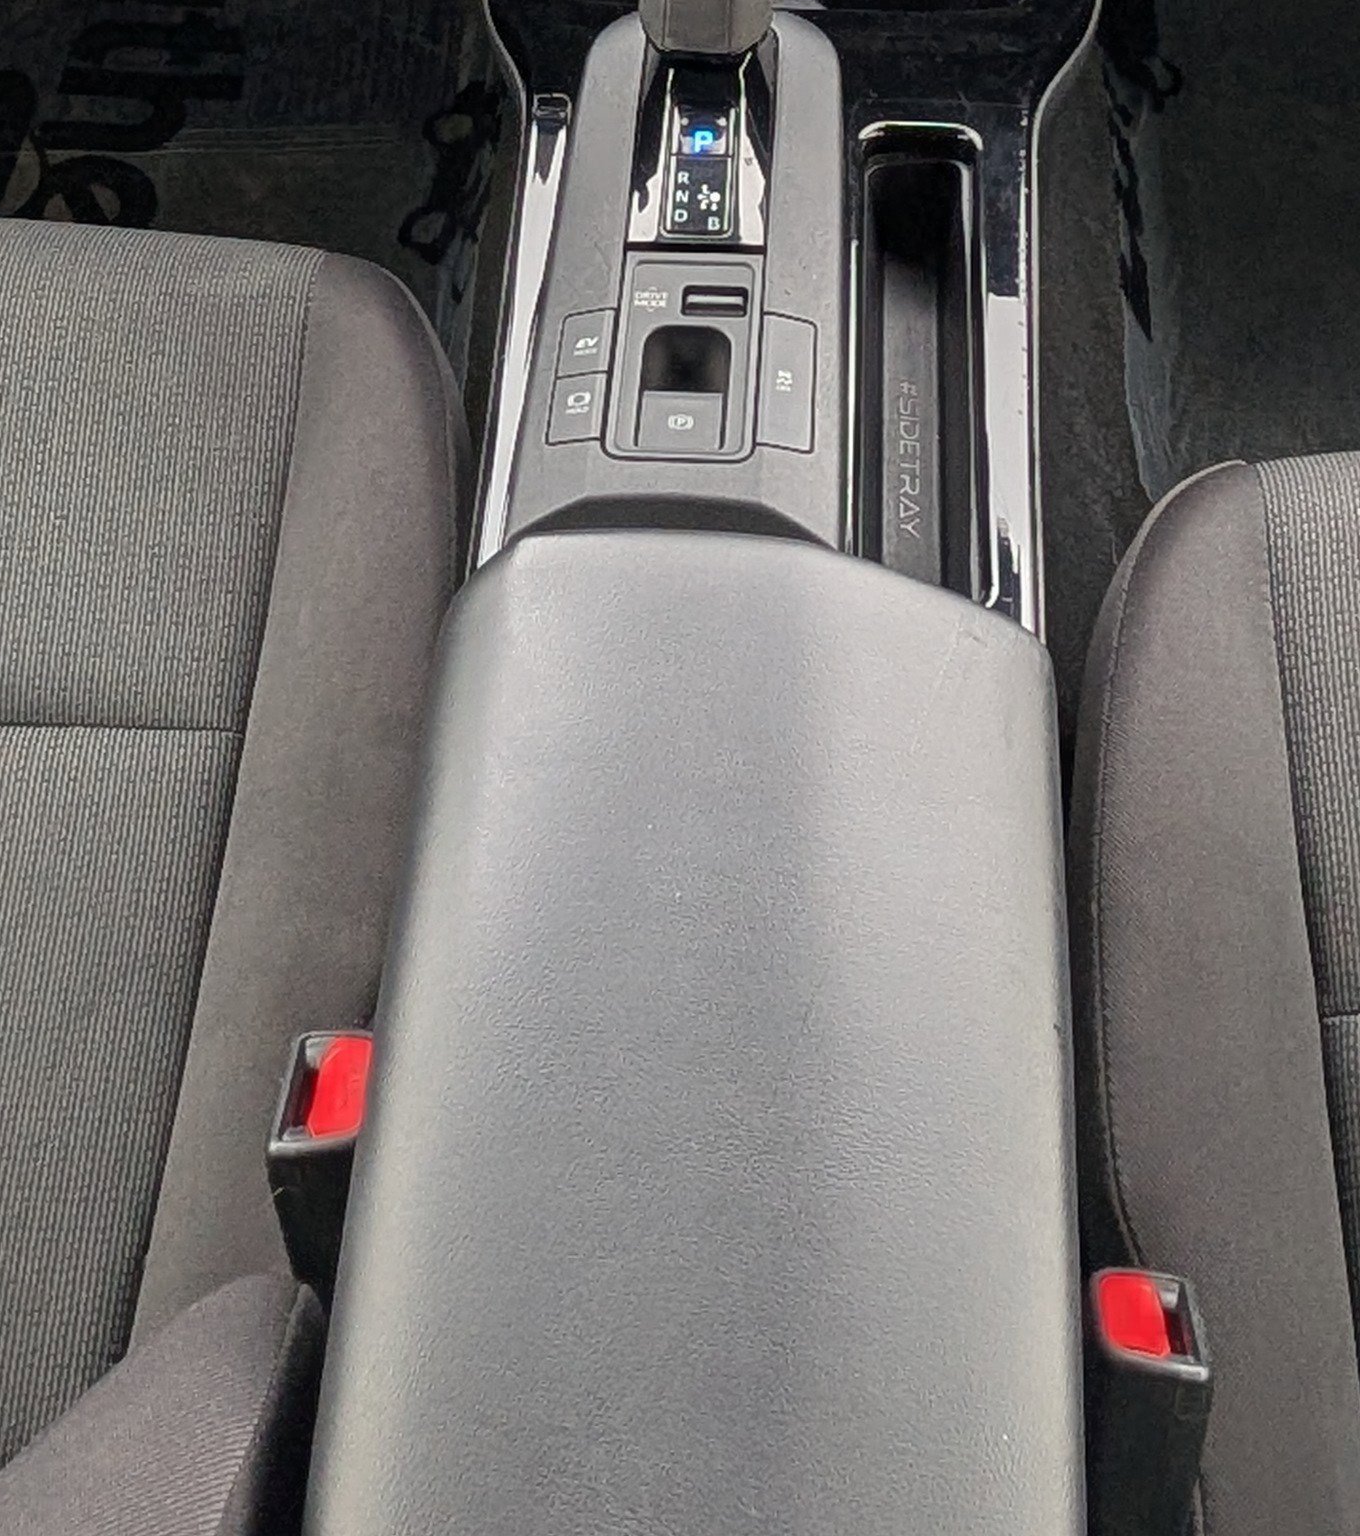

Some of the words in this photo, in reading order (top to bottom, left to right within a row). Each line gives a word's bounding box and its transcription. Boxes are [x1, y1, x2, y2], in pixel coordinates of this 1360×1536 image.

[694, 130, 714, 153] P
[677, 171, 690, 185] R
[675, 190, 689, 203] N
[673, 209, 688, 222] D
[707, 216, 721, 231] B
[899, 381, 920, 539] #SIDETRAY
